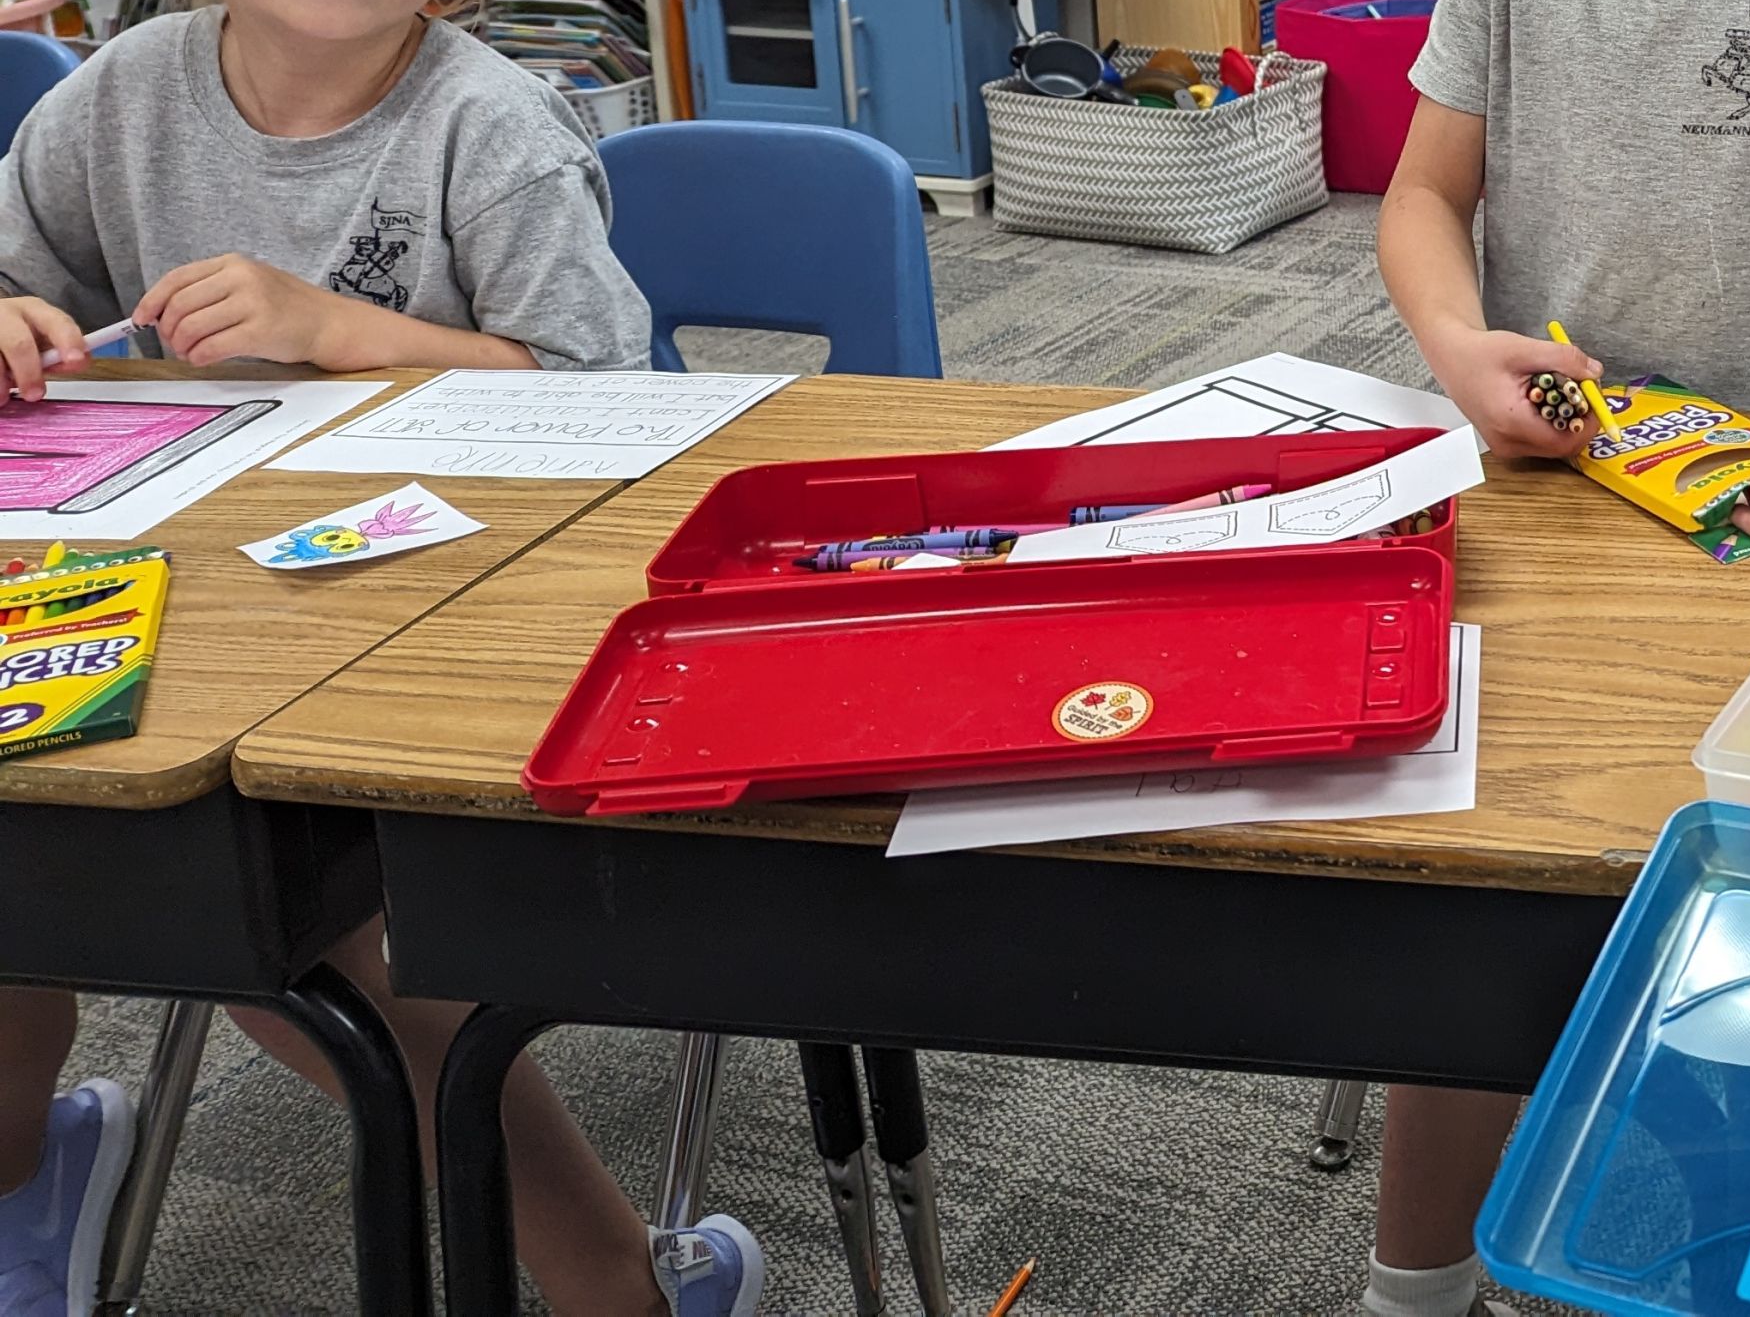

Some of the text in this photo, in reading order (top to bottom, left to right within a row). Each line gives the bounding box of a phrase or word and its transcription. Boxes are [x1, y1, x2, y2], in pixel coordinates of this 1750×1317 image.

[378, 214, 412, 228] SJNA
[1593, 411, 1731, 459] COLORED
[13, 617, 128, 641] Preferred by Teachers!
[1063, 713, 1109, 735] SPIRIT
[37, 731, 82, 749] PENCILS
